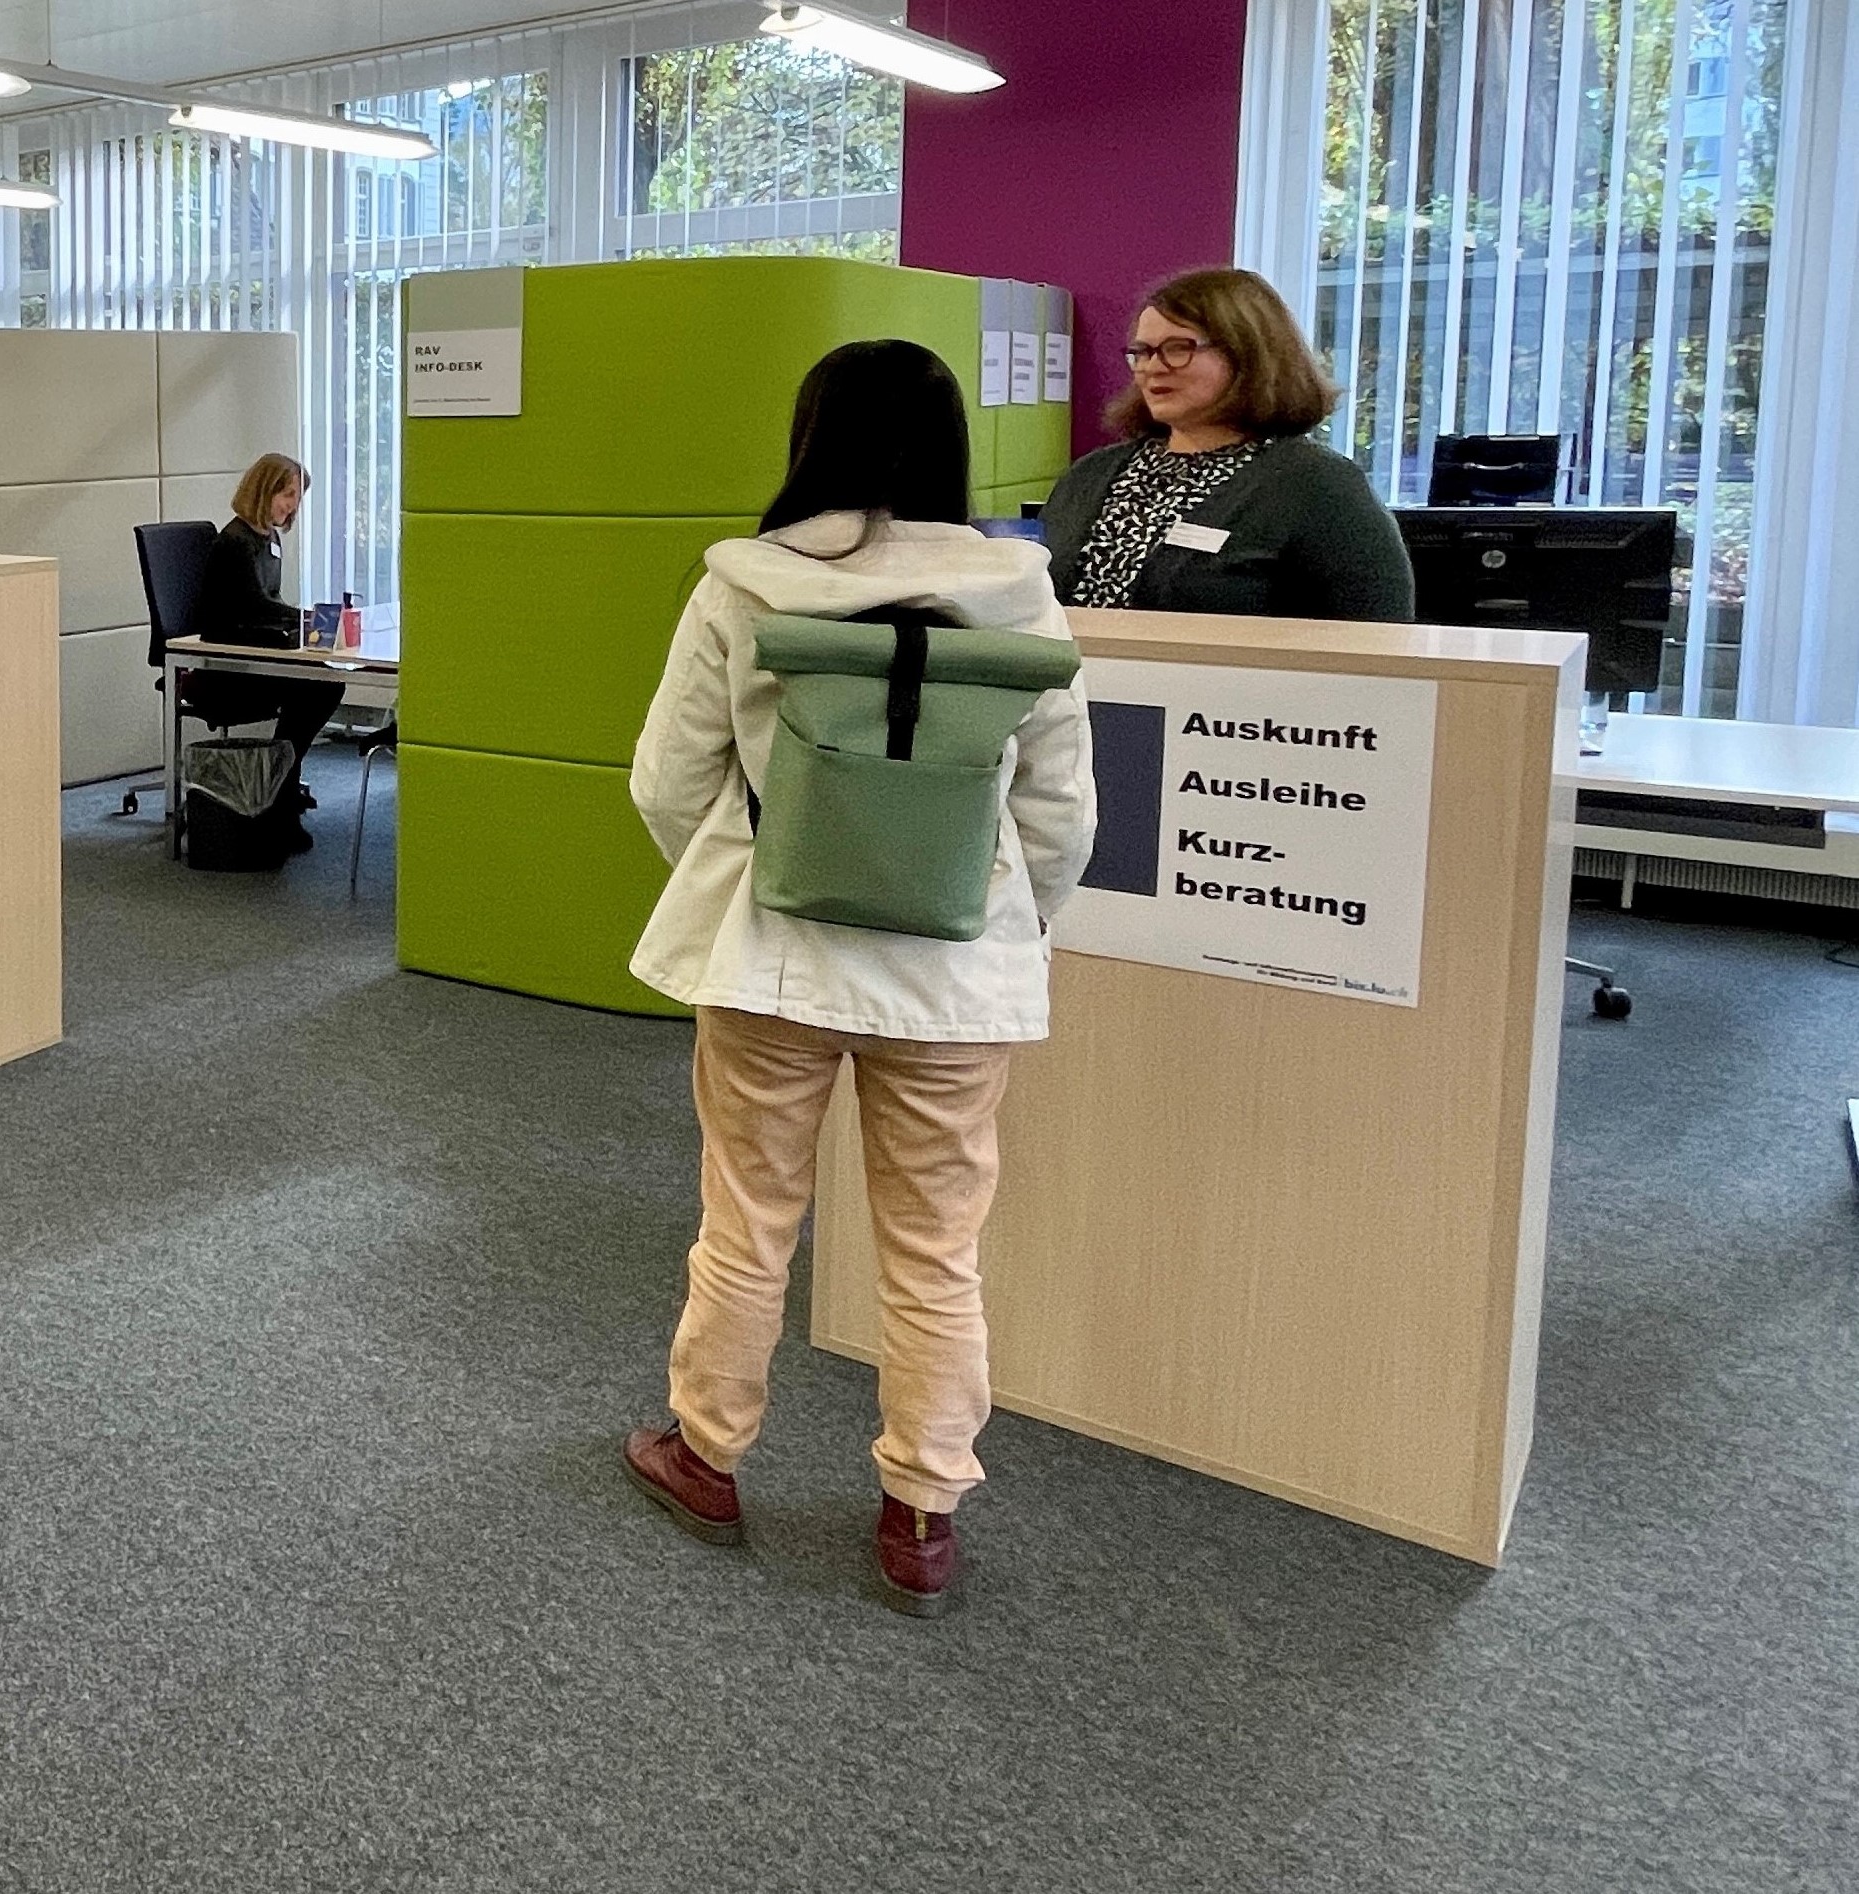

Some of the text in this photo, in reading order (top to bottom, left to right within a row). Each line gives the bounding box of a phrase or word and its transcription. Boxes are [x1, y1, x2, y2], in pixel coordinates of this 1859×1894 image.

[414, 345, 441, 356] RAV
[414, 361, 483, 373] INFO-DESK
[1181, 712, 1378, 751] Auskunft
[1178, 770, 1367, 811] Ausleihe
[1177, 828, 1286, 863] Kurz-
[1174, 871, 1367, 926] beratung
